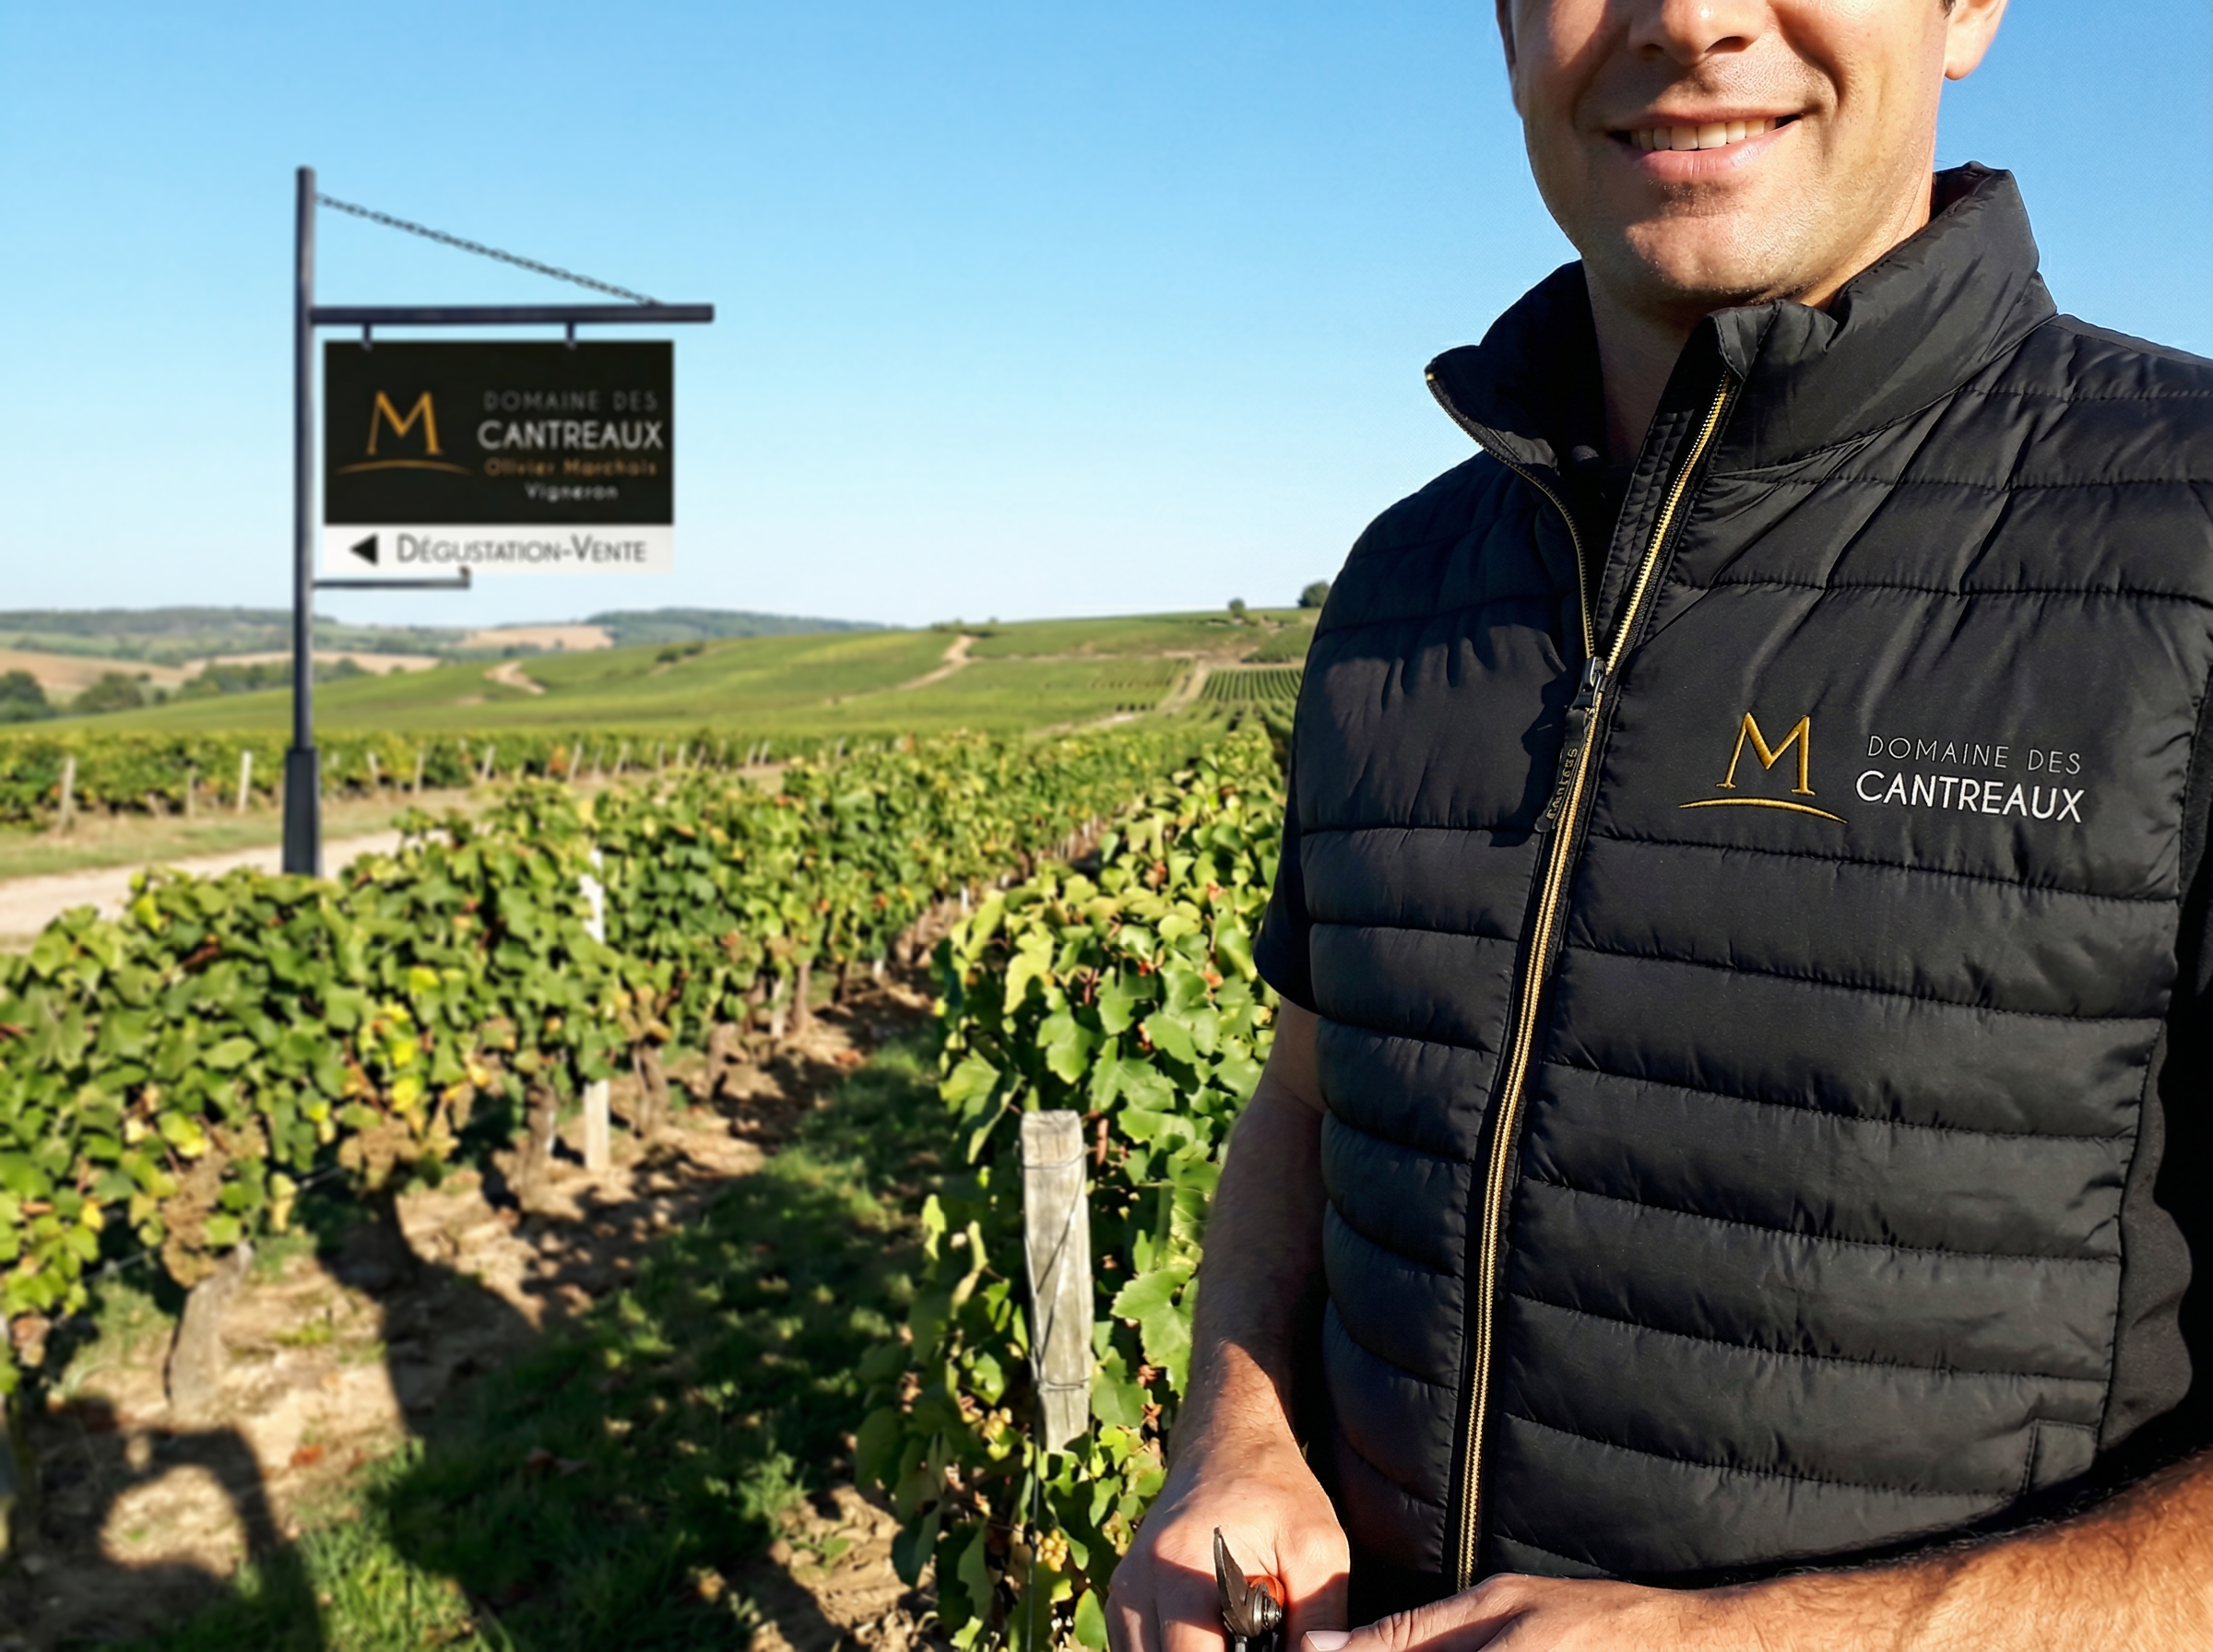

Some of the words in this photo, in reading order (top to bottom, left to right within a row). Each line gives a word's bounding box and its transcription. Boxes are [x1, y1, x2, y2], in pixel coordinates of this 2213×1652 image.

[483, 391, 600, 413] DOMAINE
[613, 391, 658, 413] DES
[366, 390, 444, 455] M
[477, 420, 665, 451] CANTREAUX
[484, 457, 556, 478] Olivier
[525, 482, 619, 503] Vigneron
[1715, 712, 1816, 796] M
[1866, 735, 2010, 769] DOMAINE
[2027, 749, 2083, 776] DES
[1854, 770, 2085, 824] CANTREAUX
